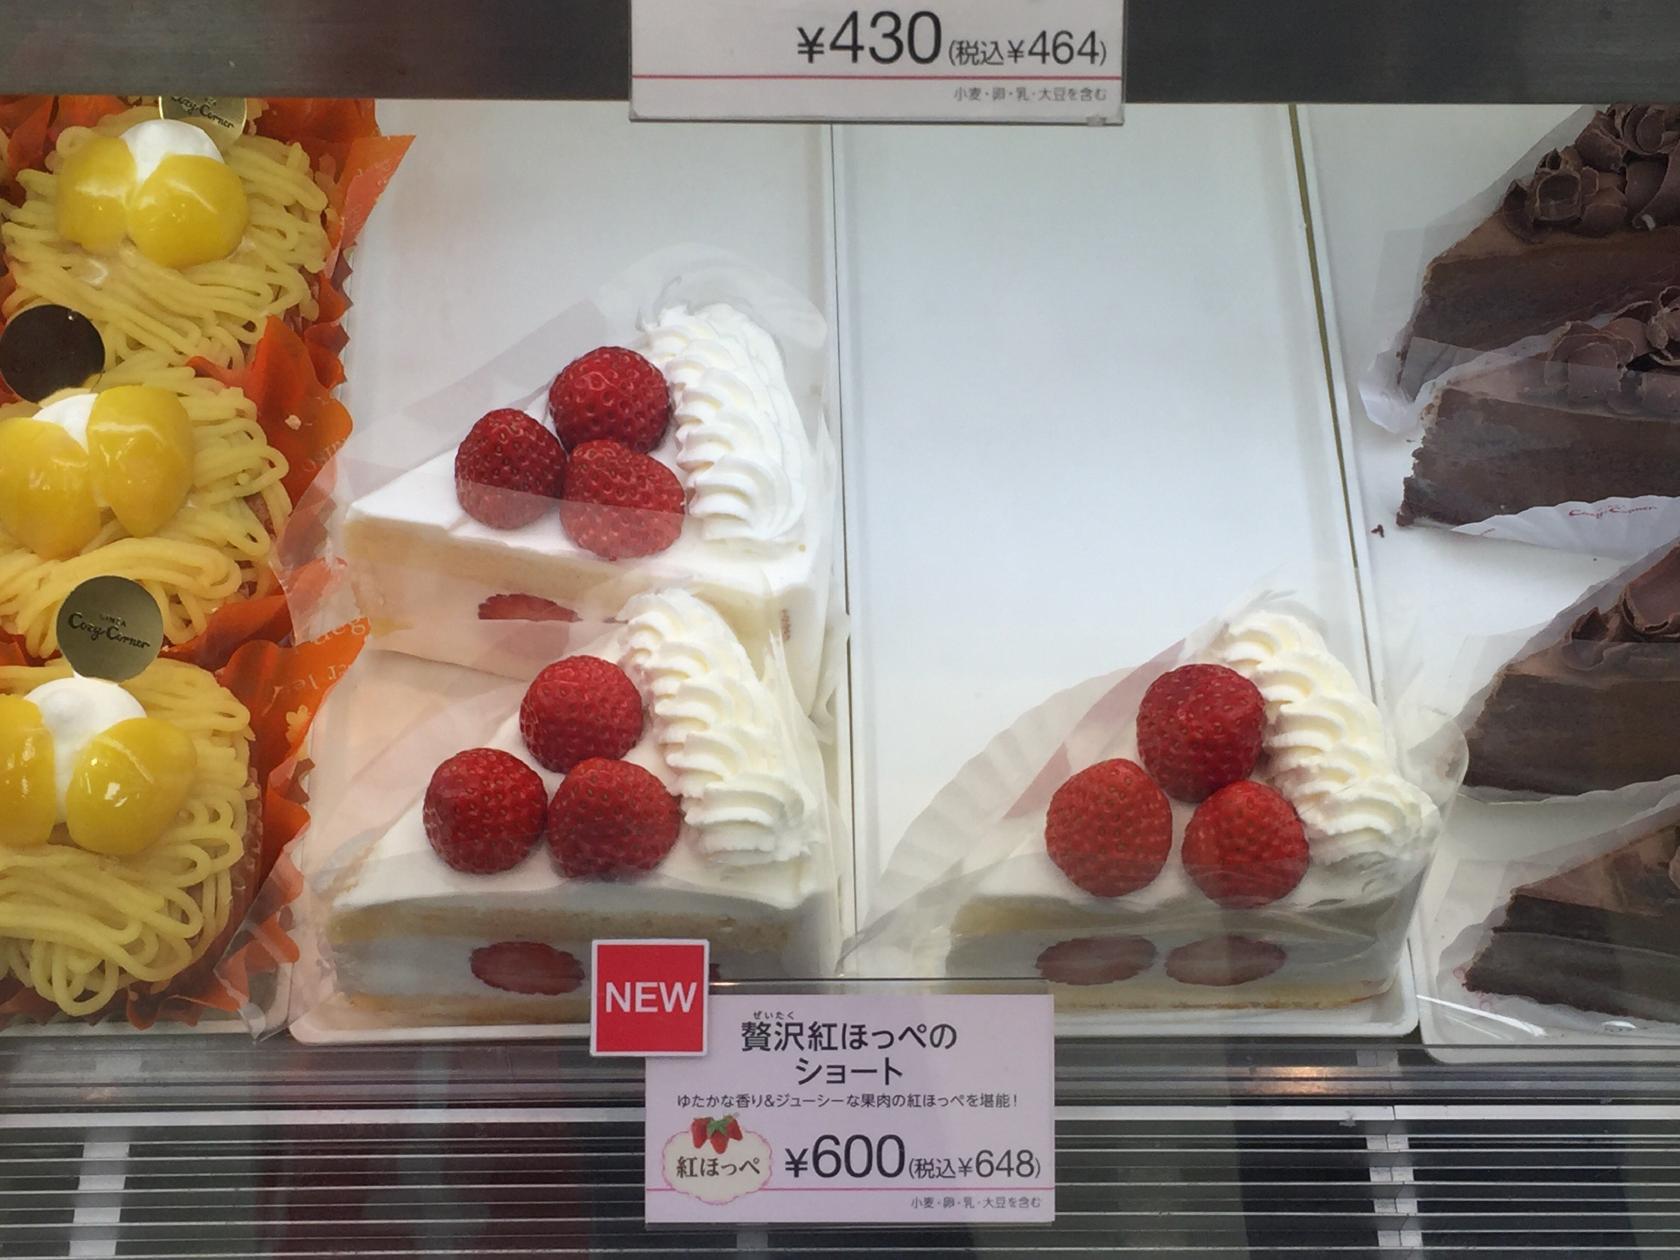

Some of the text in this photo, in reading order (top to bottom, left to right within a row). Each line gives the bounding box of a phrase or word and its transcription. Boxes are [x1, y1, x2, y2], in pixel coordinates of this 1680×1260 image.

[797, 11, 1107, 67] ¥430 (税込¥464)
[68, 611, 150, 649] Cozy Corner
[605, 982, 697, 1013] NEW
[753, 1010, 795, 1020] ぜいたく
[741, 1020, 957, 1052] 贅沢紅ほっぺの
[795, 1057, 904, 1085] ショート
[676, 1155, 760, 1178] 紅ほっぺ
[784, 1134, 1041, 1180] ¥600 (税込¥648)
